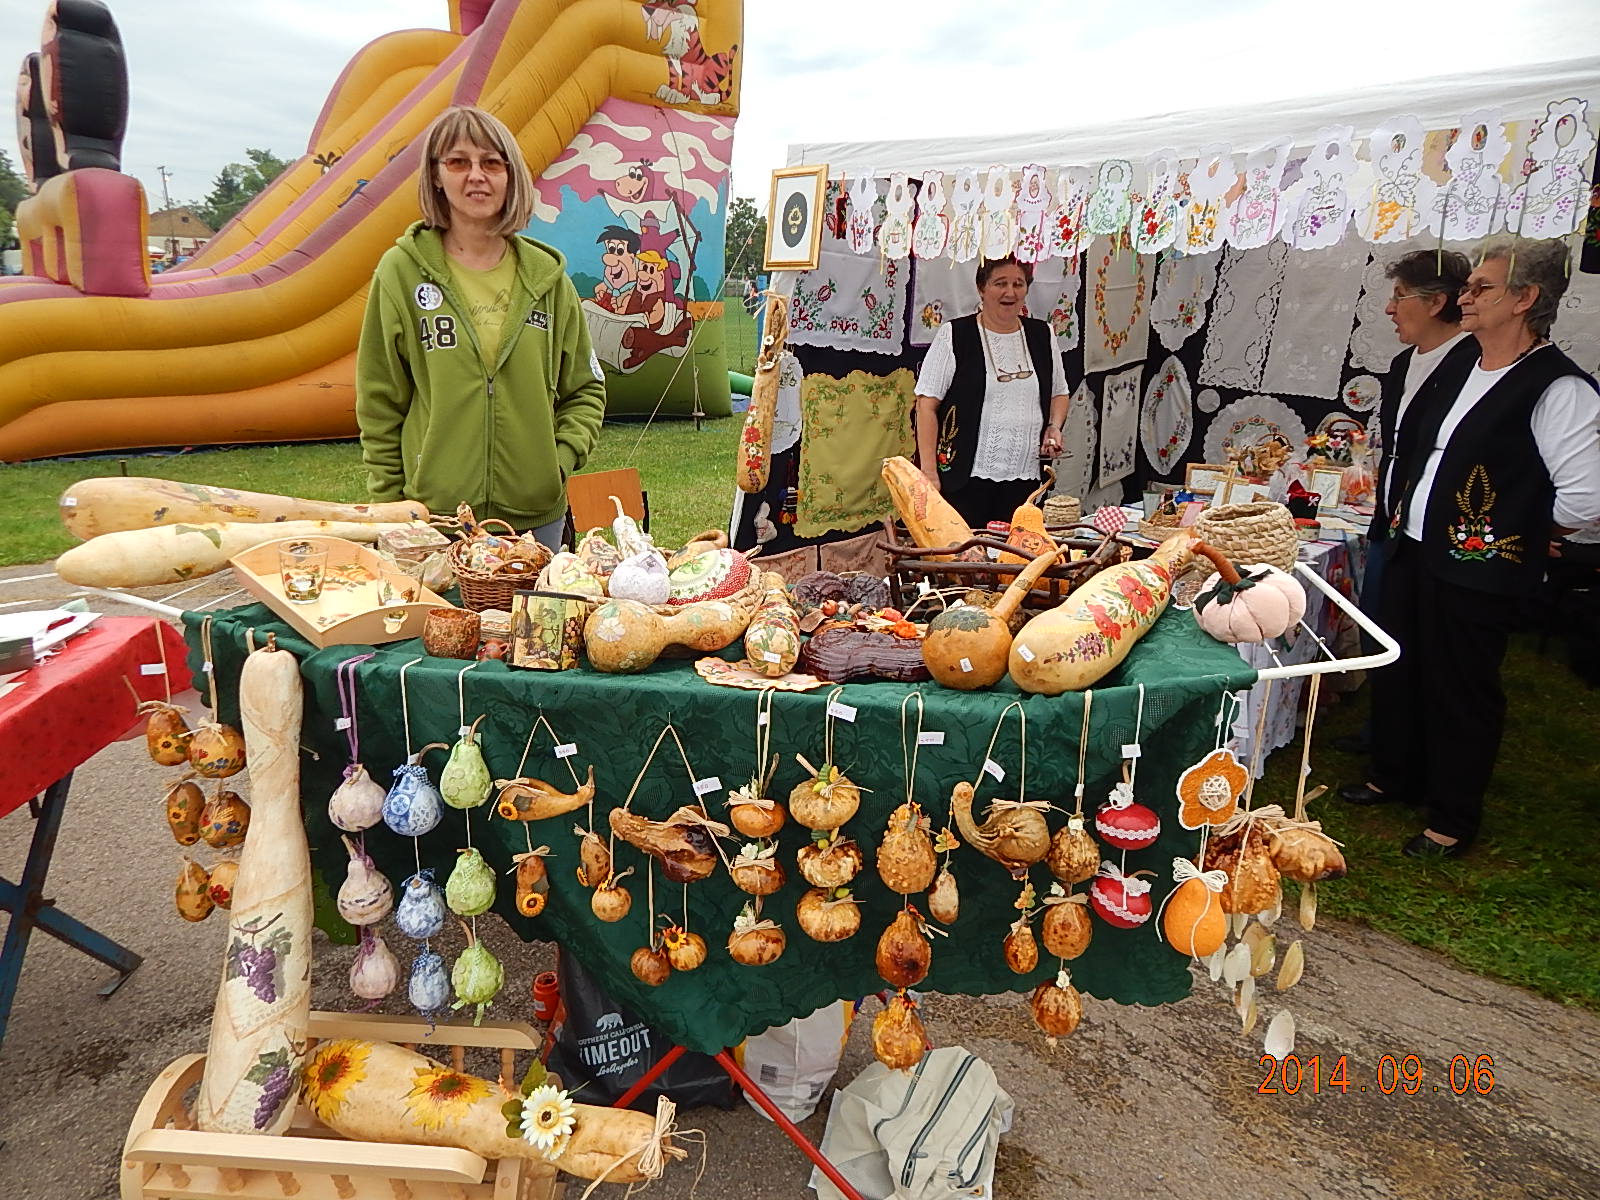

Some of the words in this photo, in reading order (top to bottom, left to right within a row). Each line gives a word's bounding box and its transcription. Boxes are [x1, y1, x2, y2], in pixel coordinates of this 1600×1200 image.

[420, 315, 457, 352] 48
[578, 1033, 609, 1046] OUTHERN
[610, 1022, 647, 1038] CALIFORNIA
[579, 1028, 651, 1066] IMEOUT
